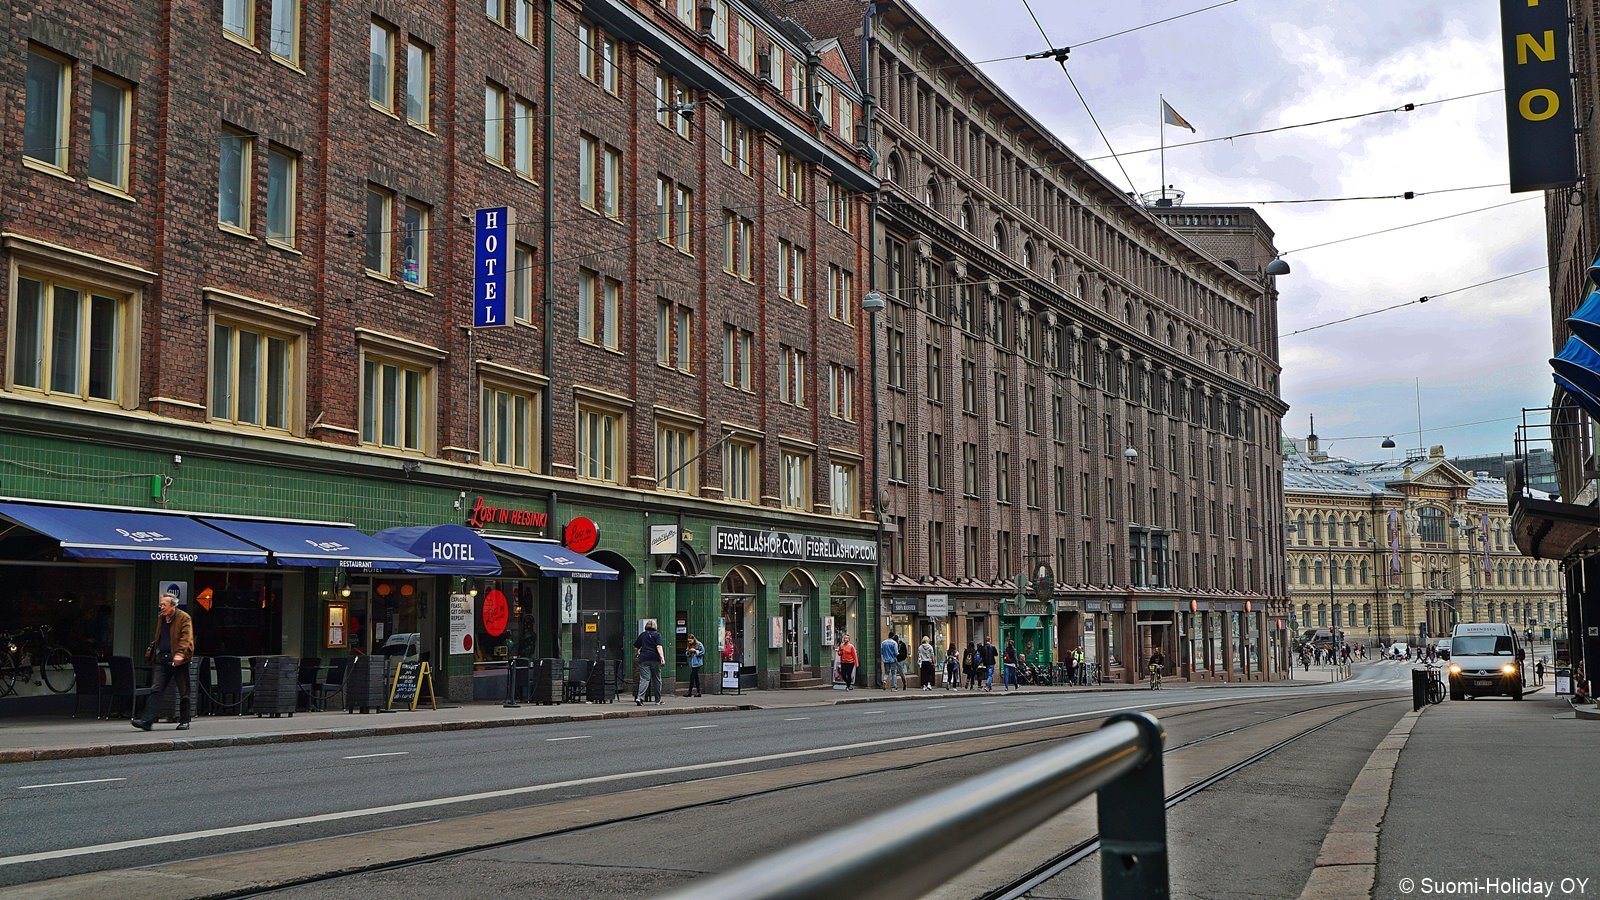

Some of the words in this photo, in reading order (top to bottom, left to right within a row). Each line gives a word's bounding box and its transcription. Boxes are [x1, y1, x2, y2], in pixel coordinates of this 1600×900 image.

[1515, 0, 1560, 121] NO
[485, 212, 498, 323] HOTEL
[498, 508, 509, 524] IN
[511, 510, 548, 528] HELSINKI
[432, 542, 475, 561] HOTEL
[718, 532, 802, 556] FIORELLASHOP.COM
[806, 540, 877, 561] FIORELLASHOP.COM
[150, 553, 178, 561] COFFEE
[179, 553, 199, 562] SHOP
[339, 560, 372, 568] RESTAURANT
